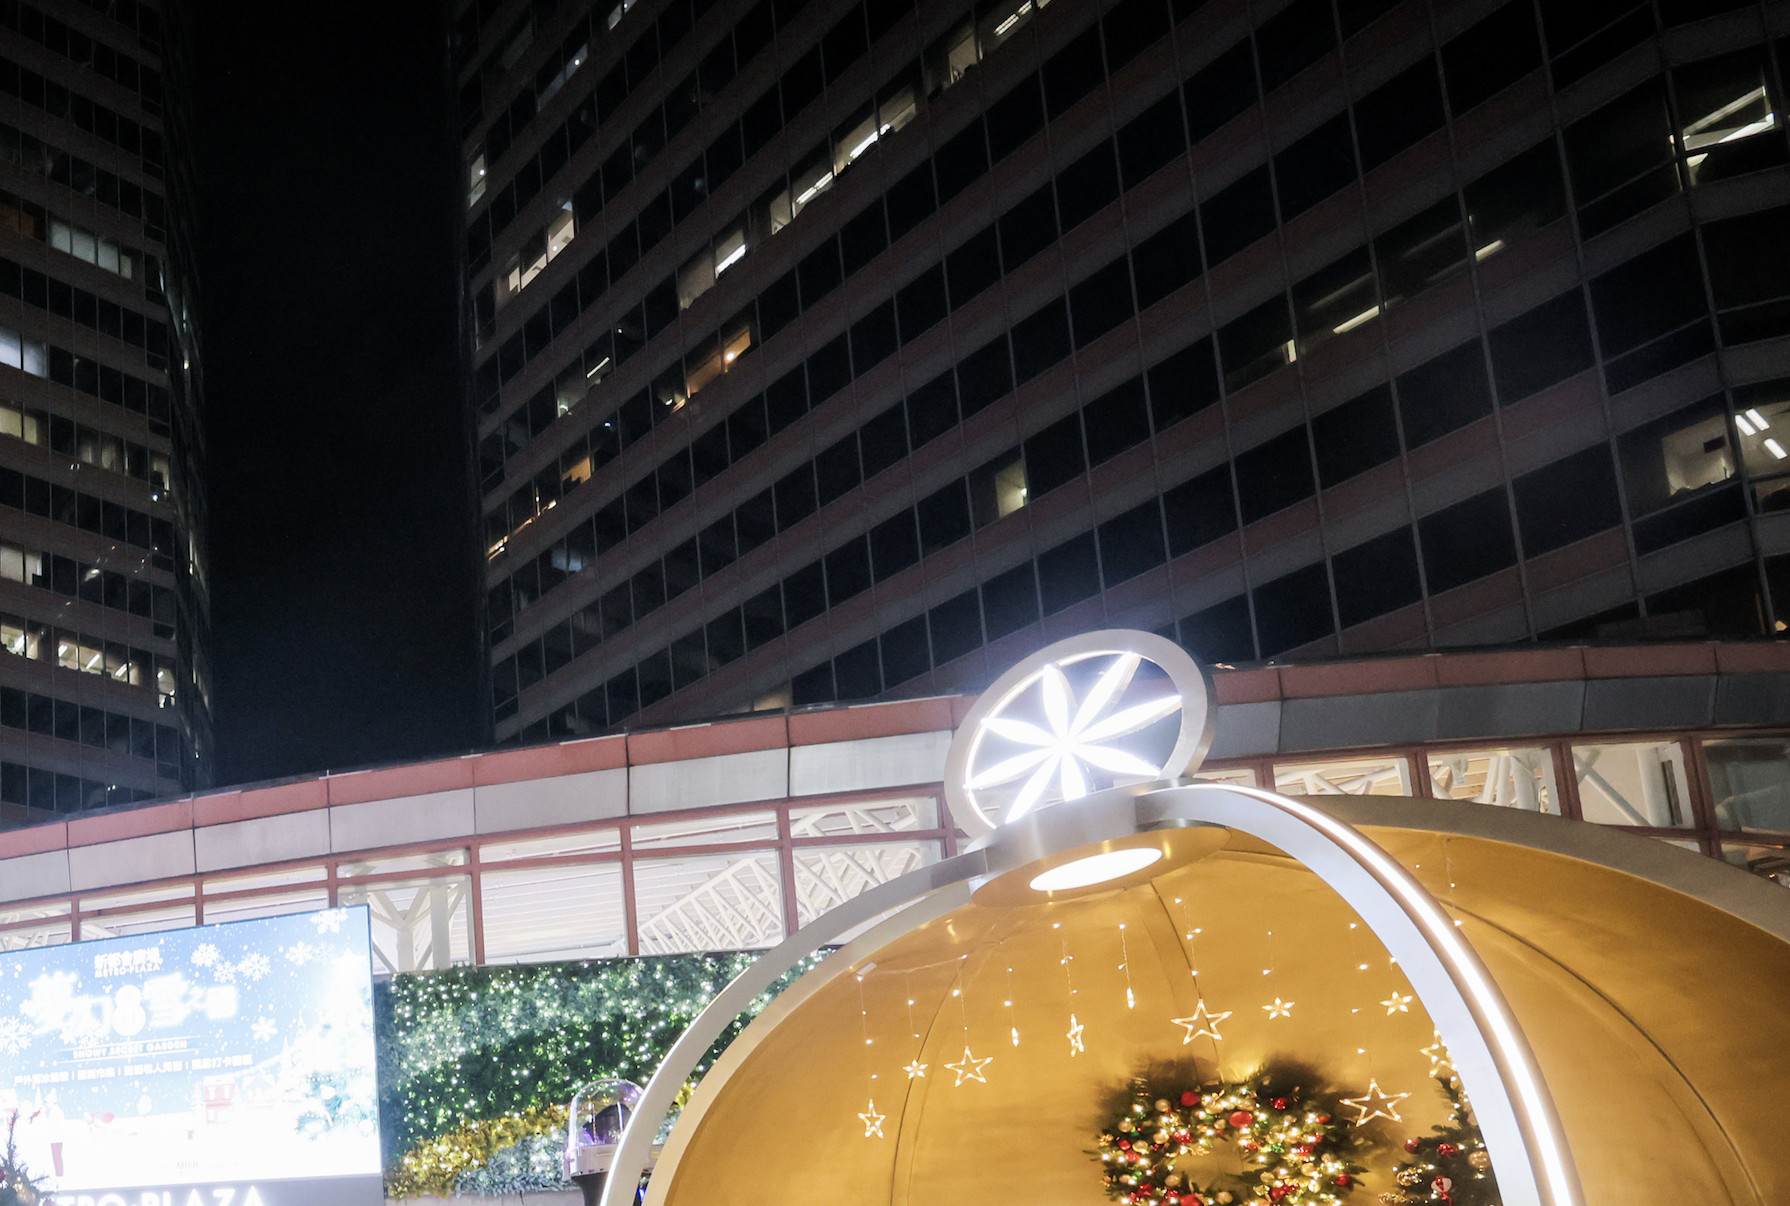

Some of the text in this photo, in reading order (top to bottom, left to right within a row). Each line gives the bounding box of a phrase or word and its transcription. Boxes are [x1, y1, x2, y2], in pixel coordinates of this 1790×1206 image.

[73, 1048, 107, 1059] SNOWY
[146, 1040, 187, 1052] GARDEN
[176, 1160, 199, 1171] MUJI
